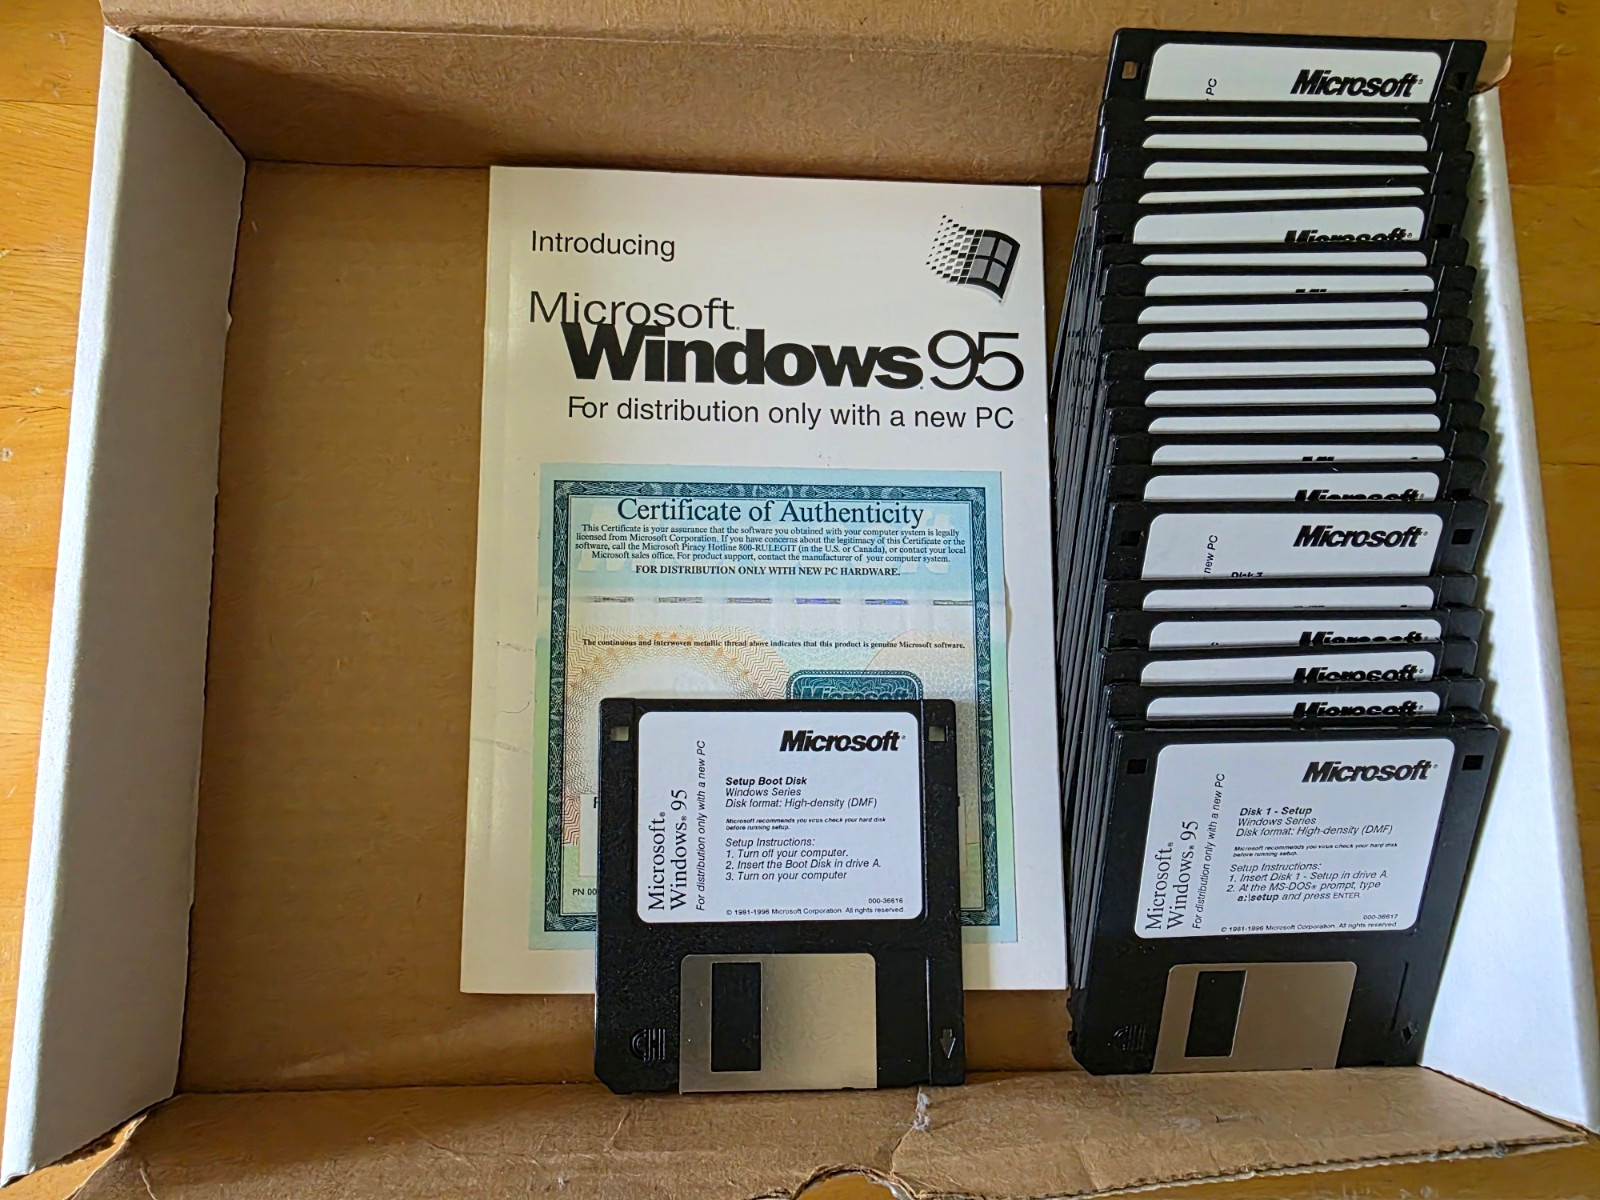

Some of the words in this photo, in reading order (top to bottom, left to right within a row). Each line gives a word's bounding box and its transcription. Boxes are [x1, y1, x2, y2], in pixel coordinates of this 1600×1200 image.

[1205, 78, 1217, 96] PC
[1290, 69, 1419, 98] Microsoft
[531, 230, 676, 262] Introducing
[529, 291, 735, 330] Microsoft
[561, 322, 923, 389] Windows
[928, 330, 1024, 391] 95
[568, 397, 608, 419] For
[617, 397, 760, 423] distribution
[769, 402, 821, 430] only
[830, 404, 881, 427] with
[890, 409, 905, 427] a
[915, 410, 967, 428] new
[976, 407, 1013, 430] PC
[617, 499, 741, 521] Certificate
[747, 500, 775, 522] of
[780, 501, 924, 528] Authenticity
[582, 524, 600, 532] This
[601, 524, 641, 532] Certificate
[727, 526, 739, 534] the
[741, 526, 773, 534] software
[775, 528, 789, 536] you
[791, 527, 824, 535] obtained
[825, 527, 842, 535] with
[844, 529, 861, 537] your
[863, 528, 898, 537] computer
[900, 528, 926, 538] system
[935, 529, 959, 538] legally
[1293, 525, 1422, 548] Microsoft
[576, 533, 607, 541] licensed
[608, 533, 628, 541] from
[629, 533, 668, 541] Microsoft
[669, 534, 719, 544] Corporation.
[745, 535, 763, 543] have
[823, 536, 835, 544] the
[837, 536, 875, 546] legitimacy
[902, 537, 941, 545] Certificate
[1207, 534, 1218, 551] PC
[592, 551, 629, 559] Microsoft
[631, 551, 650, 559] sales
[693, 552, 722, 561] product
[724, 552, 756, 562] support,
[801, 553, 852, 561] manufacturer
[866, 555, 884, 563] your
[885, 554, 921, 563] computer
[923, 554, 950, 564] system.
[1204, 552, 1214, 574] new
[636, 566, 658, 574] FOR
[660, 566, 736, 574] DISTRIBUTION
[738, 566, 765, 574] ONLY
[769, 567, 796, 575] WITH
[799, 567, 822, 575] NEW
[825, 567, 838, 575] PC
[840, 567, 900, 576] HARDWARE.
[697, 740, 706, 756] PC
[779, 730, 899, 752] Microsoft
[1302, 760, 1430, 783] Microsoft
[726, 777, 755, 787] Setup
[758, 777, 782, 785] Boot
[786, 777, 807, 785] Disk
[671, 789, 687, 810] 95
[726, 788, 768, 796] Windows
[772, 788, 801, 796] Series
[697, 791, 705, 810] with
[726, 799, 746, 808] Disk
[750, 799, 782, 807] format:
[785, 799, 844, 809] High-density
[848, 798, 877, 809] (DMF)
[1240, 808, 1261, 816] Disk
[1281, 807, 1312, 817] Setup
[697, 815, 707, 834] only
[1238, 818, 1282, 826] Windows
[1285, 817, 1316, 825] Series
[1180, 820, 1199, 841] 95
[1236, 828, 1258, 836] Disk
[1261, 828, 1294, 836] format:
[1297, 826, 1359, 837] High-density
[1362, 825, 1392, 835] (DMF)
[726, 839, 753, 849] Setup
[757, 838, 815, 846] Instructions:
[726, 850, 734, 858] 1.
[738, 850, 759, 858] Turn
[777, 851, 797, 860] your
[800, 849, 848, 859] computer.
[696, 836, 705, 892] distribution
[737, 861, 764, 869] Insert
[767, 861, 782, 869] the
[786, 860, 807, 868] Boot
[811, 860, 831, 868] Disk
[846, 859, 869, 867] drive
[873, 859, 880, 867] A.
[1230, 864, 1258, 874] Setup
[1261, 863, 1322, 872] Instructions:
[726, 873, 734, 881] 3.
[738, 872, 759, 880] Turn
[777, 873, 798, 882] your
[802, 872, 847, 881] computer
[1229, 875, 1236, 883] 1.
[1240, 874, 1267, 882] Insert
[1270, 873, 1292, 881] Disk
[1310, 872, 1338, 881] Setup
[1341, 871, 1350, 879] in
[1353, 870, 1377, 879] drive
[1239, 884, 1248, 892] At
[1320, 881, 1356, 891] prompt,
[1360, 881, 1381, 890] type
[696, 895, 705, 911] For
[1304, 893, 1330, 901] press
